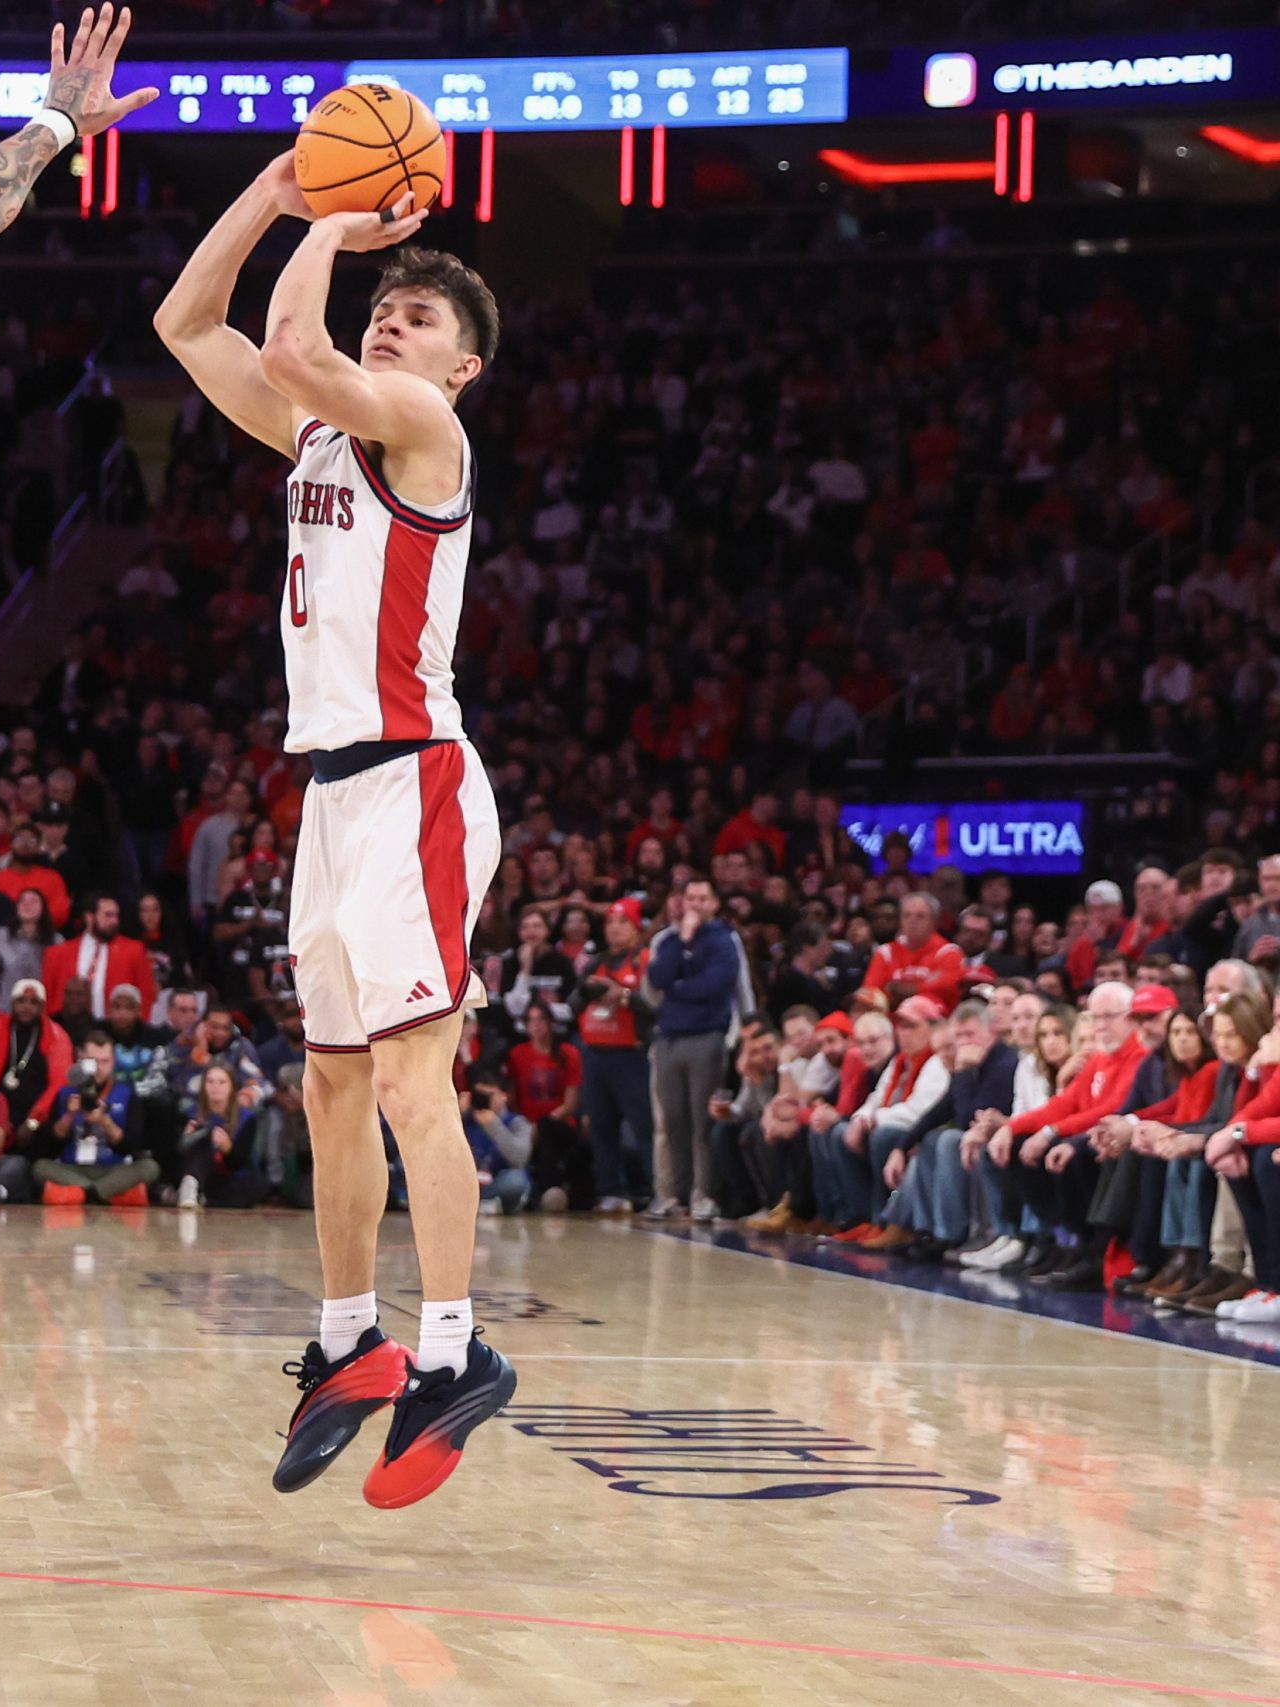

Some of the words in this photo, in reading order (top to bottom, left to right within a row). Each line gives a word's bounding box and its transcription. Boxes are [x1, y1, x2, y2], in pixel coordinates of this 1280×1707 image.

[993, 53, 1233, 93] @THEGARDEN
[238, 96, 256, 122] 1
[292, 96, 308, 122] 1
[289, 552, 308, 628] 0
[959, 821, 1084, 857] ULTRA
